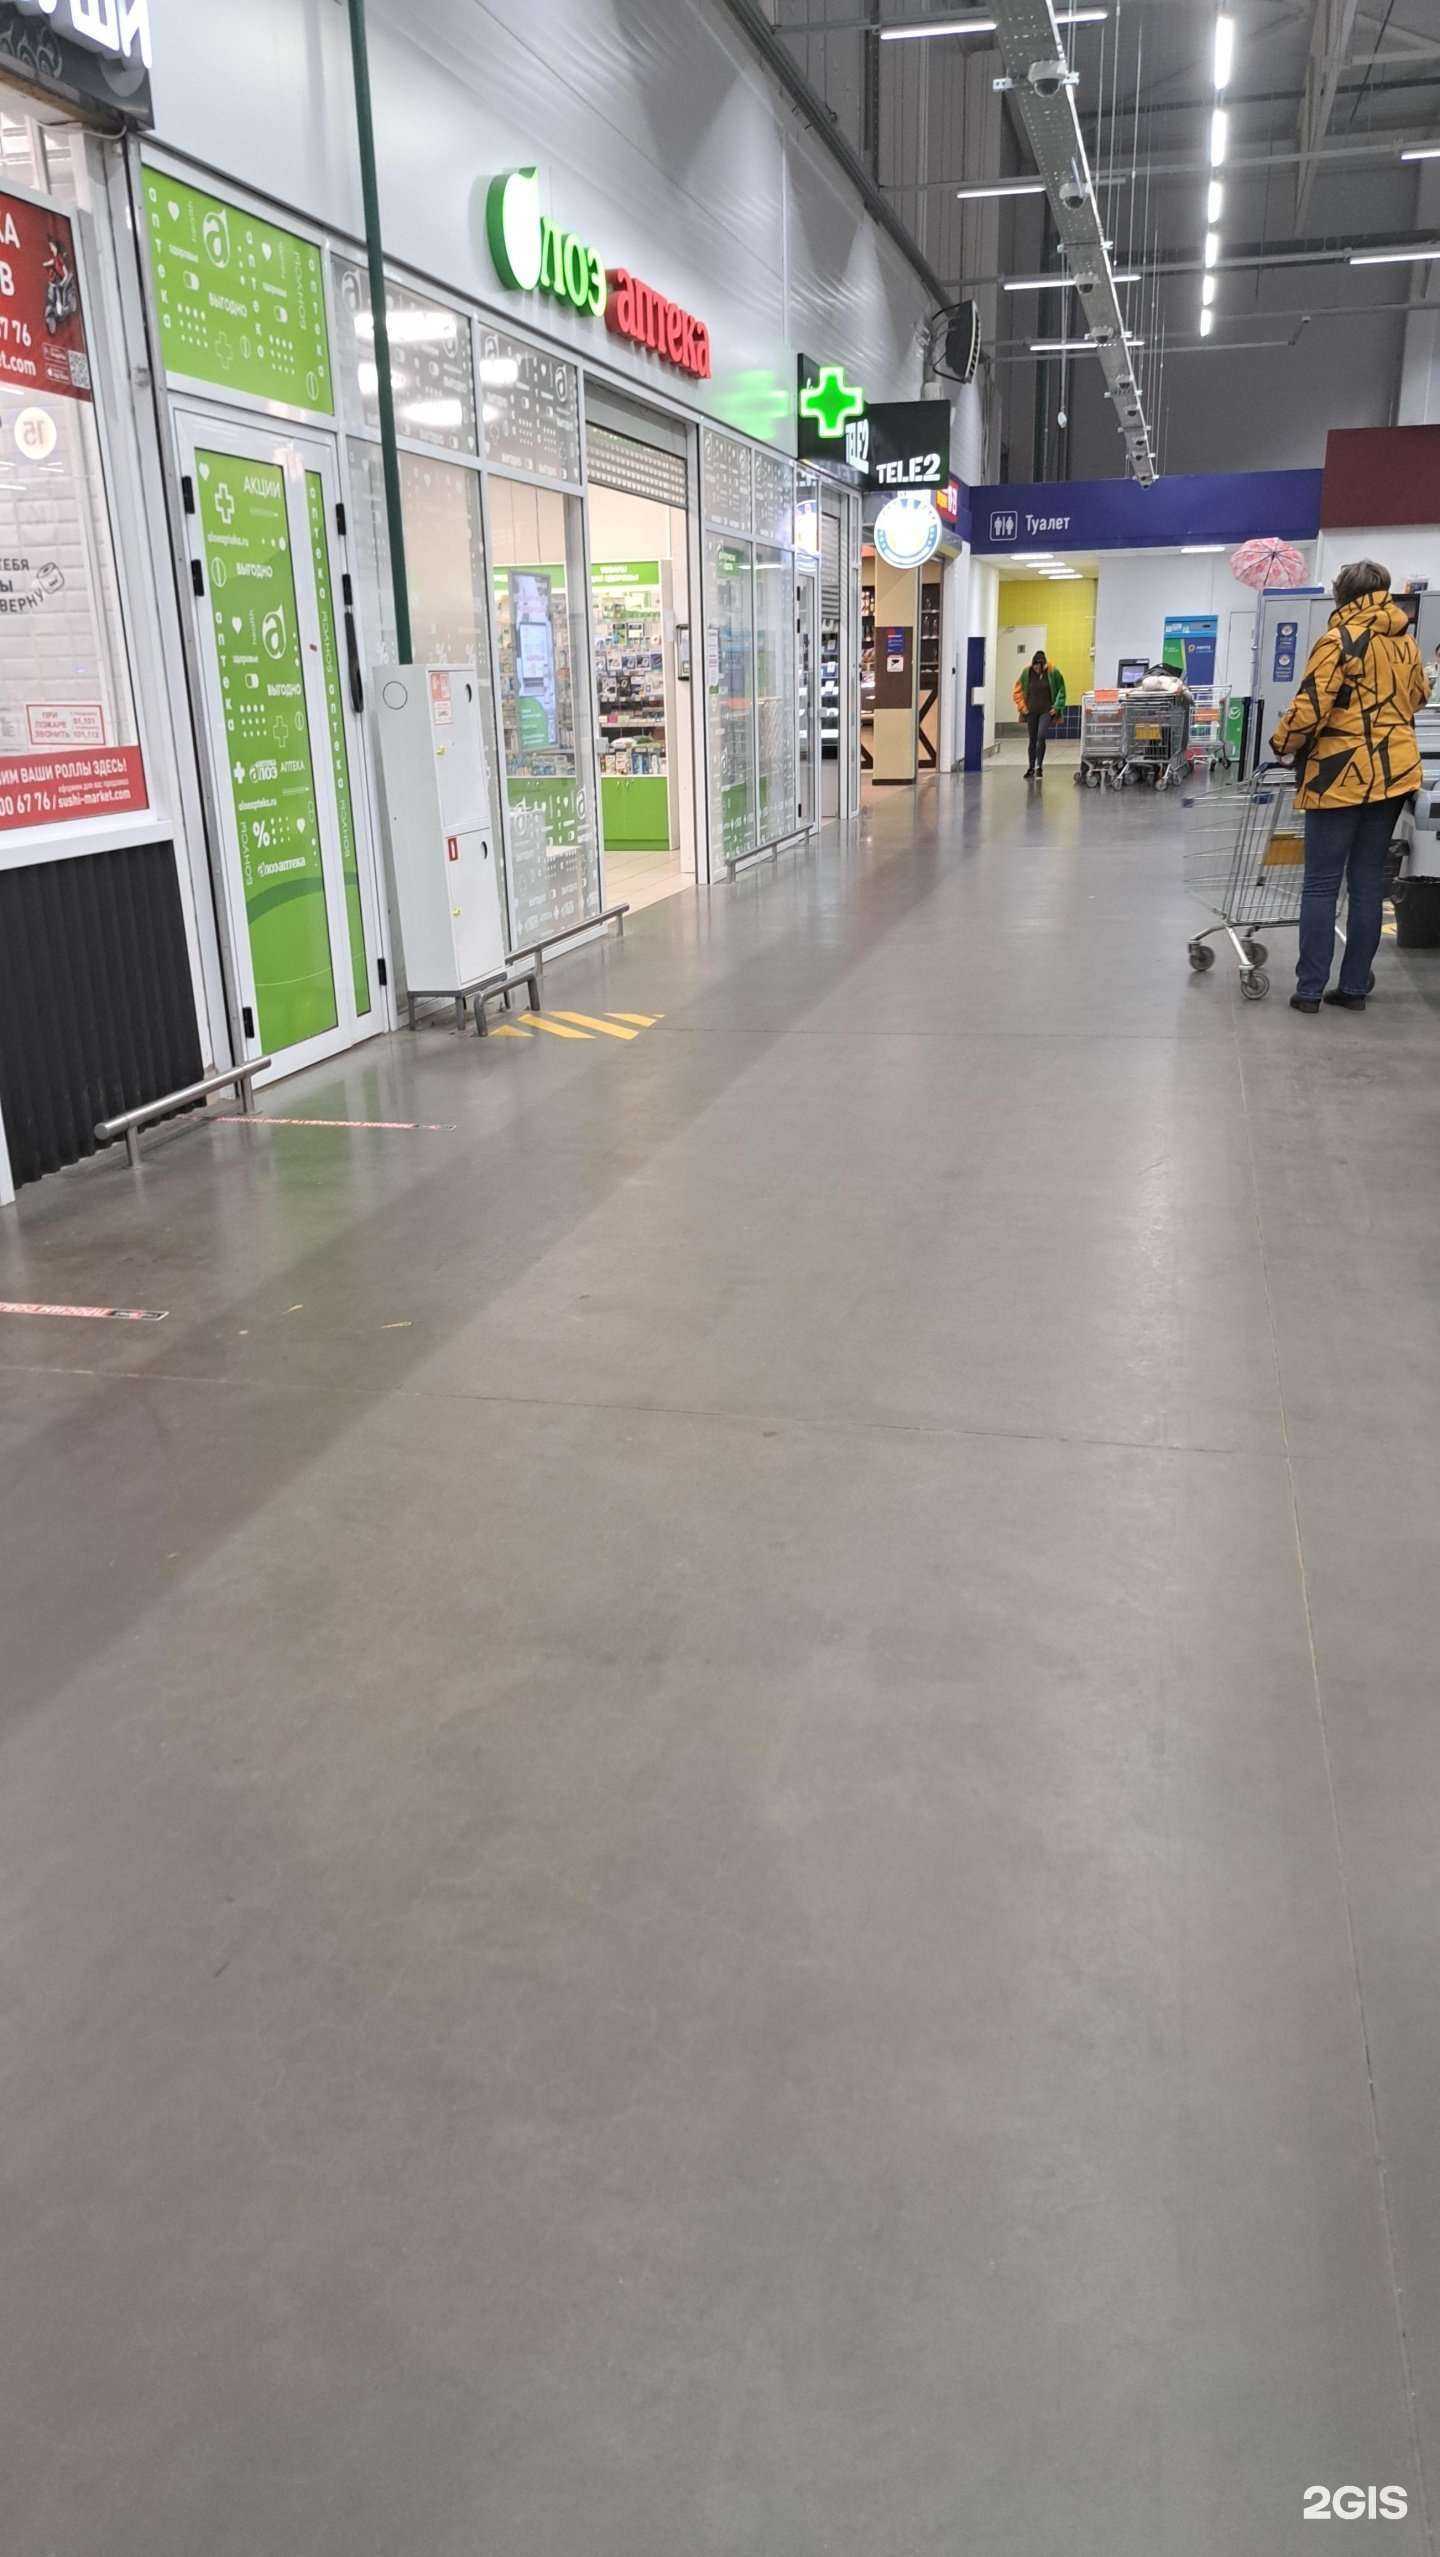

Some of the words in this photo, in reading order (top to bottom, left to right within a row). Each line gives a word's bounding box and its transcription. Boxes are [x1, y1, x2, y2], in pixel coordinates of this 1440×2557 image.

[38, 0, 152, 69] ШИ
[0, 315, 9, 341] 7
[11, 319, 32, 347] 76
[614, 267, 712, 379] аптека
[0, 350, 37, 377] t.com
[876, 453, 941, 484] TELE2
[243, 476, 281, 499] АКЦИИ
[1025, 514, 1071, 536] Туалет
[20, 764, 54, 784] ВАШИ
[55, 760, 92, 779] РОЛЛЫ
[93, 757, 128, 777] ЗДЕСЬ!
[17, 793, 31, 814] 67
[35, 791, 51, 811] 76
[58, 789, 131, 808] sushi-market.com
